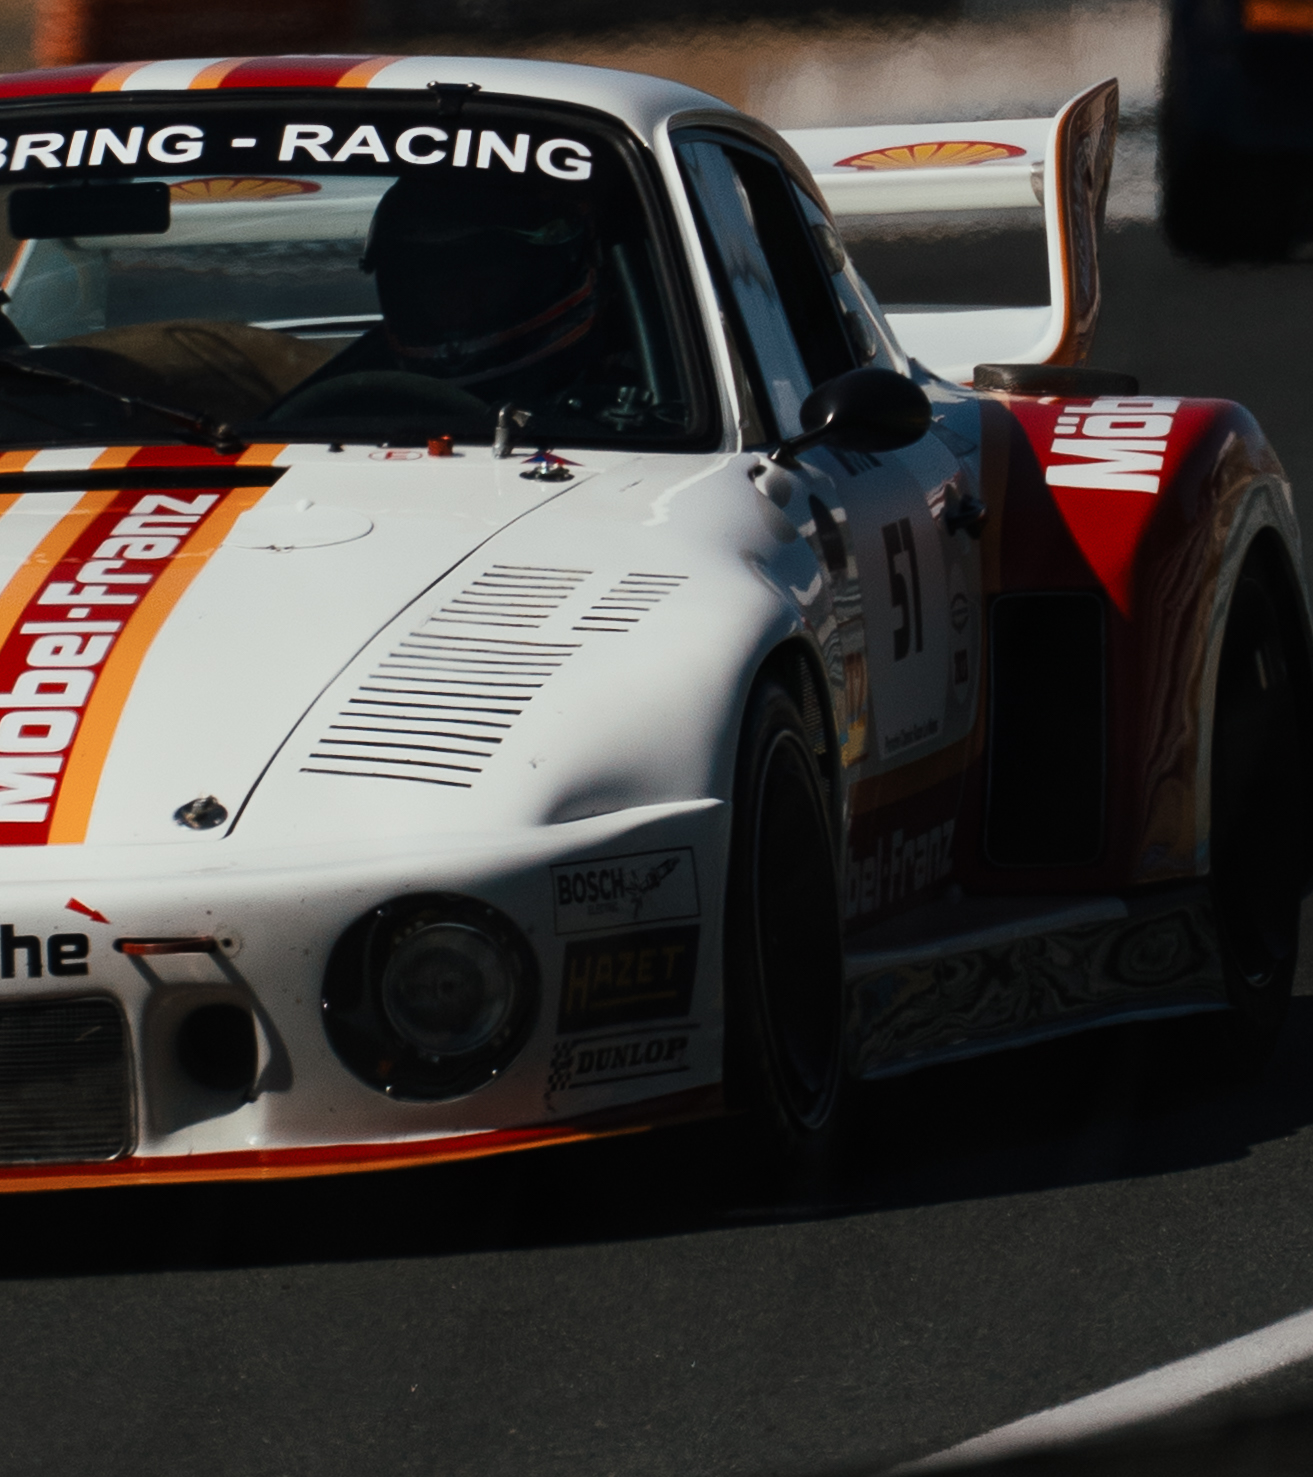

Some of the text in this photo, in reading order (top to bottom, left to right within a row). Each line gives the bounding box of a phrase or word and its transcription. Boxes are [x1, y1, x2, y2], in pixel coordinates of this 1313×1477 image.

[278, 123, 594, 182] RACING
[882, 517, 923, 663] 51
[556, 867, 624, 905] BOSCH
[564, 945, 686, 1015] HAZET
[576, 1037, 688, 1074] DUNLOP
